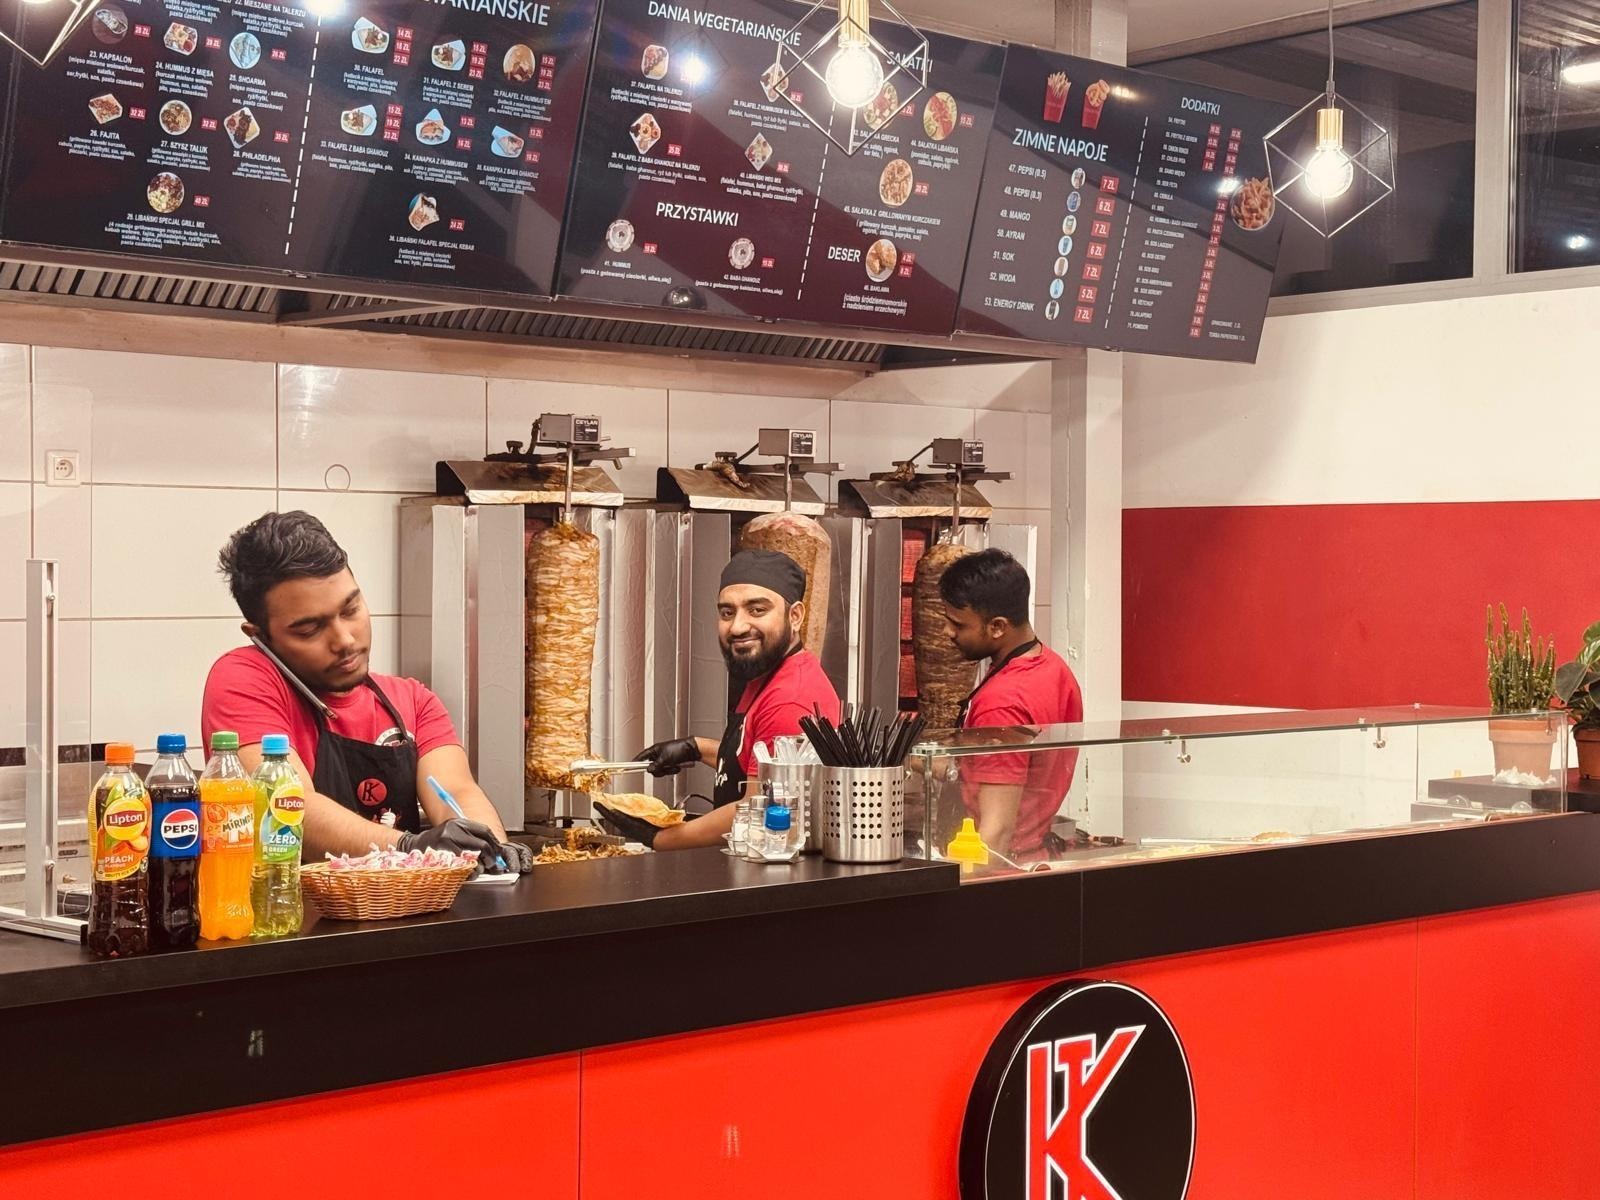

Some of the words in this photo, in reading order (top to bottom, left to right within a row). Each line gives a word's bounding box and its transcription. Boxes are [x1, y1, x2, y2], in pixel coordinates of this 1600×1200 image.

[648, 1, 691, 24] DANIA
[693, 13, 802, 46] WEGETARIAŃSKIE
[89, 50, 97, 58] 23.
[99, 52, 132, 64] KAPSALON
[155, 61, 163, 69] 24.
[165, 63, 190, 73] HUMMUS
[362, 66, 384, 75] FALAFEL
[238, 75, 266, 86] SHOARMA
[431, 78, 451, 87] FALAFEL
[638, 82, 656, 91] FALAFEL
[1181, 97, 1221, 116] DODATKI
[100, 131, 120, 140] FAJITA
[328, 141, 348, 151] FALAFEL
[353, 145, 366, 154] BABA
[1012, 128, 1056, 152] ZIMNE
[1058, 137, 1108, 162] NAPOJE
[242, 152, 280, 163] PHILADELPHIA
[412, 154, 435, 164] KANAPKA
[618, 153, 637, 161] FALAFEL
[641, 156, 654, 164] BABA
[1008, 164, 1017, 173] 47.
[1018, 165, 1035, 176] PEPSI
[1013, 187, 1030, 198] PEPSI
[655, 201, 739, 227] PRZYSTAWKI
[1000, 209, 1008, 218] 49.
[1009, 210, 1031, 221] MANGO
[181, 219, 195, 227] GRILL
[997, 229, 1005, 238] 50.
[1006, 230, 1025, 240] AYRAN
[419, 238, 438, 247] FALAFEL
[828, 246, 861, 262] DESER
[992, 250, 1001, 260] 51.
[1002, 252, 1015, 261] SOK
[989, 272, 997, 281] 52.
[998, 273, 1016, 283] WODA
[844, 293, 860, 303] (ciasto
[984, 297, 993, 306] 53.
[993, 298, 1017, 310] ENERGY
[1017, 301, 1035, 311] DRINK
[110, 814, 143, 825] Lipton
[163, 825, 198, 834] PEPSI
[269, 835, 297, 845] ZERO
[105, 855, 133, 863] PEACH
